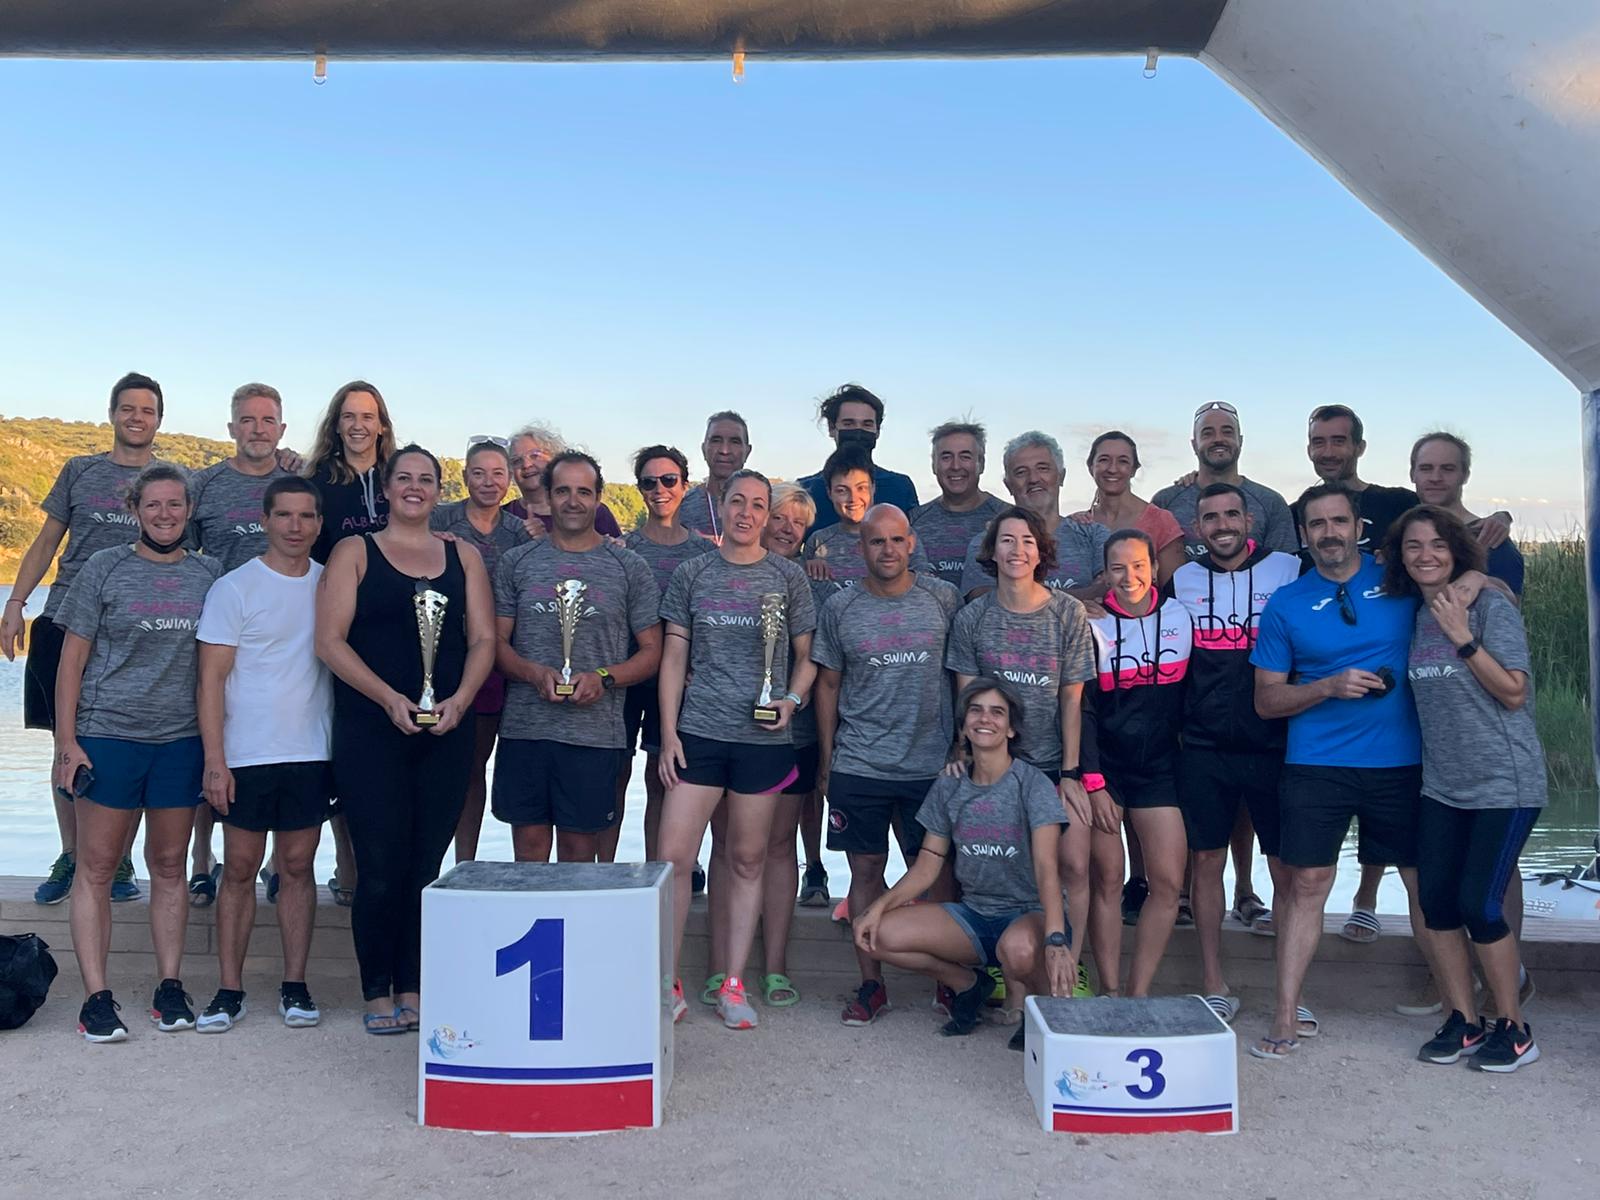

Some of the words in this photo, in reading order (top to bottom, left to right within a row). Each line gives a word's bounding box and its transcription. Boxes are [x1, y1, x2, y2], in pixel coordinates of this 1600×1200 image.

[106, 512, 141, 527] SWIM
[155, 618, 191, 631] SWIM
[719, 615, 755, 627] SWIM
[1198, 613, 1262, 643] DSC
[1161, 628, 1179, 638] DSC
[883, 651, 916, 665] SWIM
[1110, 648, 1179, 683] DSC
[1003, 670, 1037, 685] SWIM
[1416, 665, 1442, 680] SWIM
[972, 843, 1004, 857] SWIM
[495, 918, 564, 1041] 1
[1125, 1048, 1166, 1100] 3
